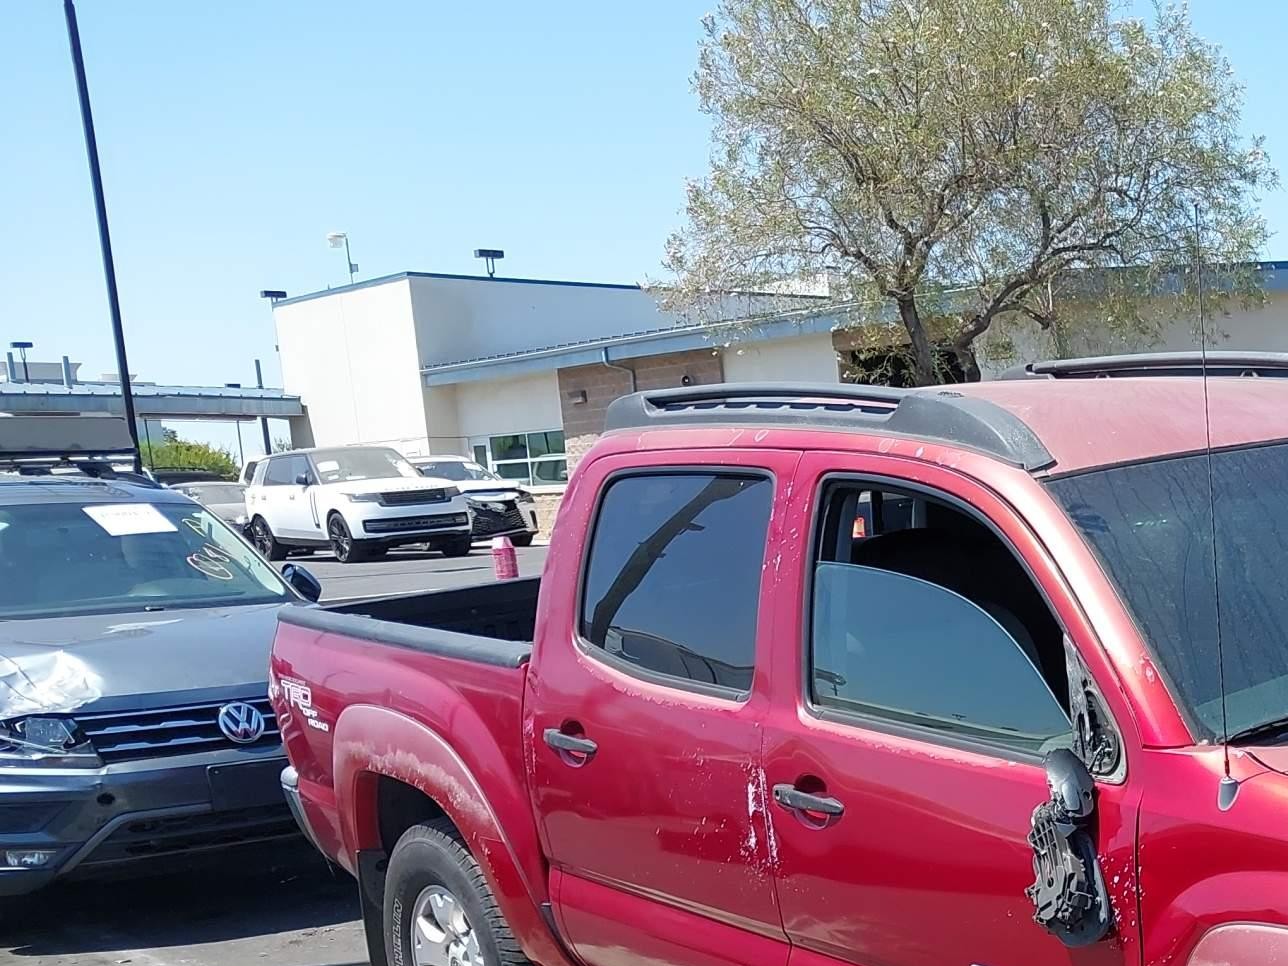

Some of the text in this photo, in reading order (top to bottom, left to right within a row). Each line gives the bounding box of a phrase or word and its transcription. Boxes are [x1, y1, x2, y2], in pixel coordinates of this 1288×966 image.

[280, 679, 312, 711] TRD
[302, 707, 318, 718] OFF
[307, 718, 329, 732] ROAD
